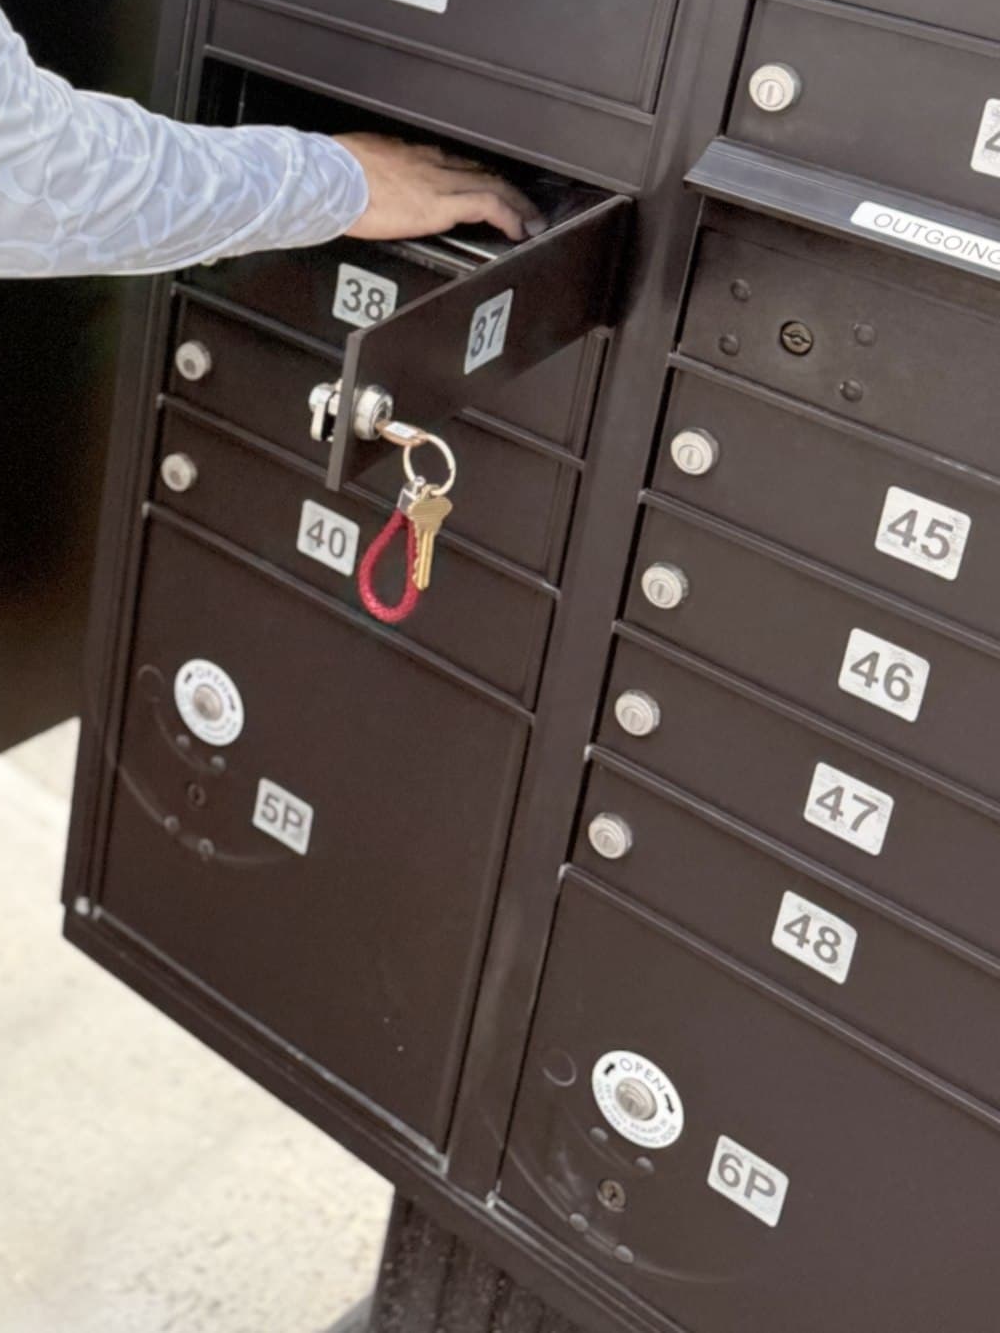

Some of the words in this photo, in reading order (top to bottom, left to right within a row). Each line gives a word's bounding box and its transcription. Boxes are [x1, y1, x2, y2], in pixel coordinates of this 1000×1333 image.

[873, 213, 1000, 265] OUTGOING
[342, 278, 385, 322] 38
[470, 306, 505, 357] 37
[306, 519, 347, 559] 40
[888, 509, 953, 560] 45
[850, 651, 913, 702] 46
[261, 793, 303, 832] 5P
[816, 786, 879, 832] 47
[784, 914, 841, 964] 48
[619, 1058, 665, 1091] OPEN
[718, 1153, 776, 1200] 6P
